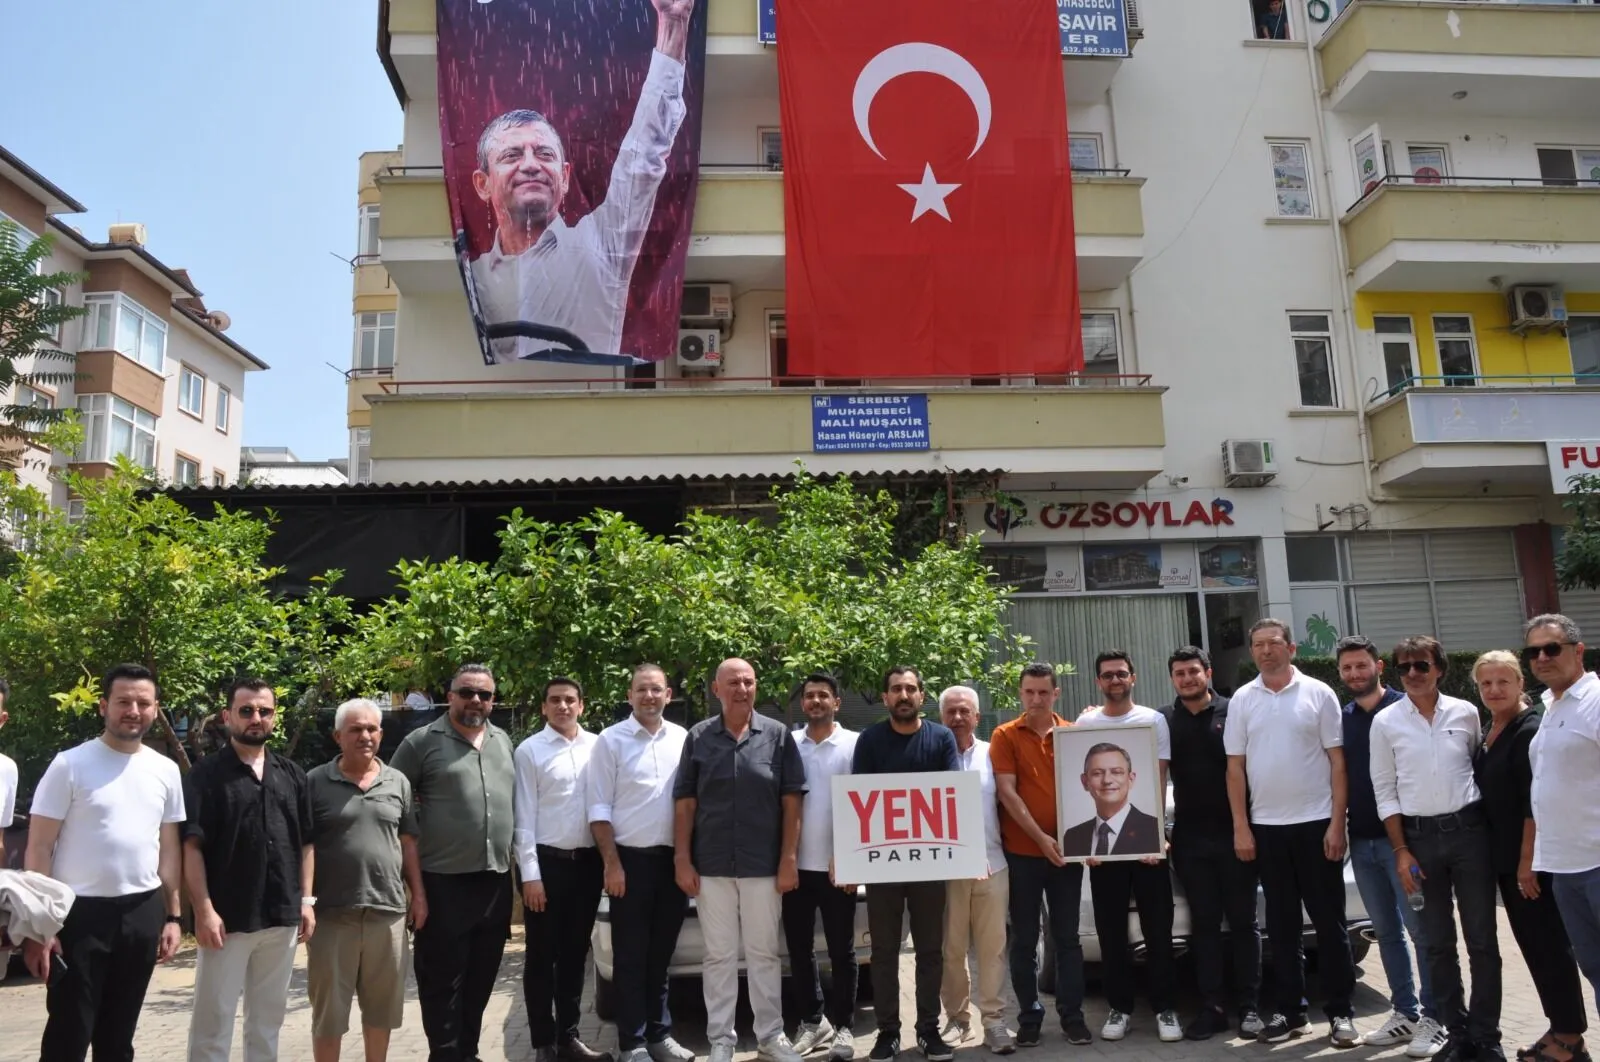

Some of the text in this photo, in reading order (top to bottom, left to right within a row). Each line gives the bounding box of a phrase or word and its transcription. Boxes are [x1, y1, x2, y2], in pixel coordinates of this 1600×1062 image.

[1068, 34, 1099, 44] ER
[848, 396, 910, 404] SERBEST
[828, 406, 911, 416] MUHASEBECİ
[821, 416, 922, 428] MALİ MÜŞAVİR
[817, 430, 925, 441] Hasan Hüseyin ARSLAN
